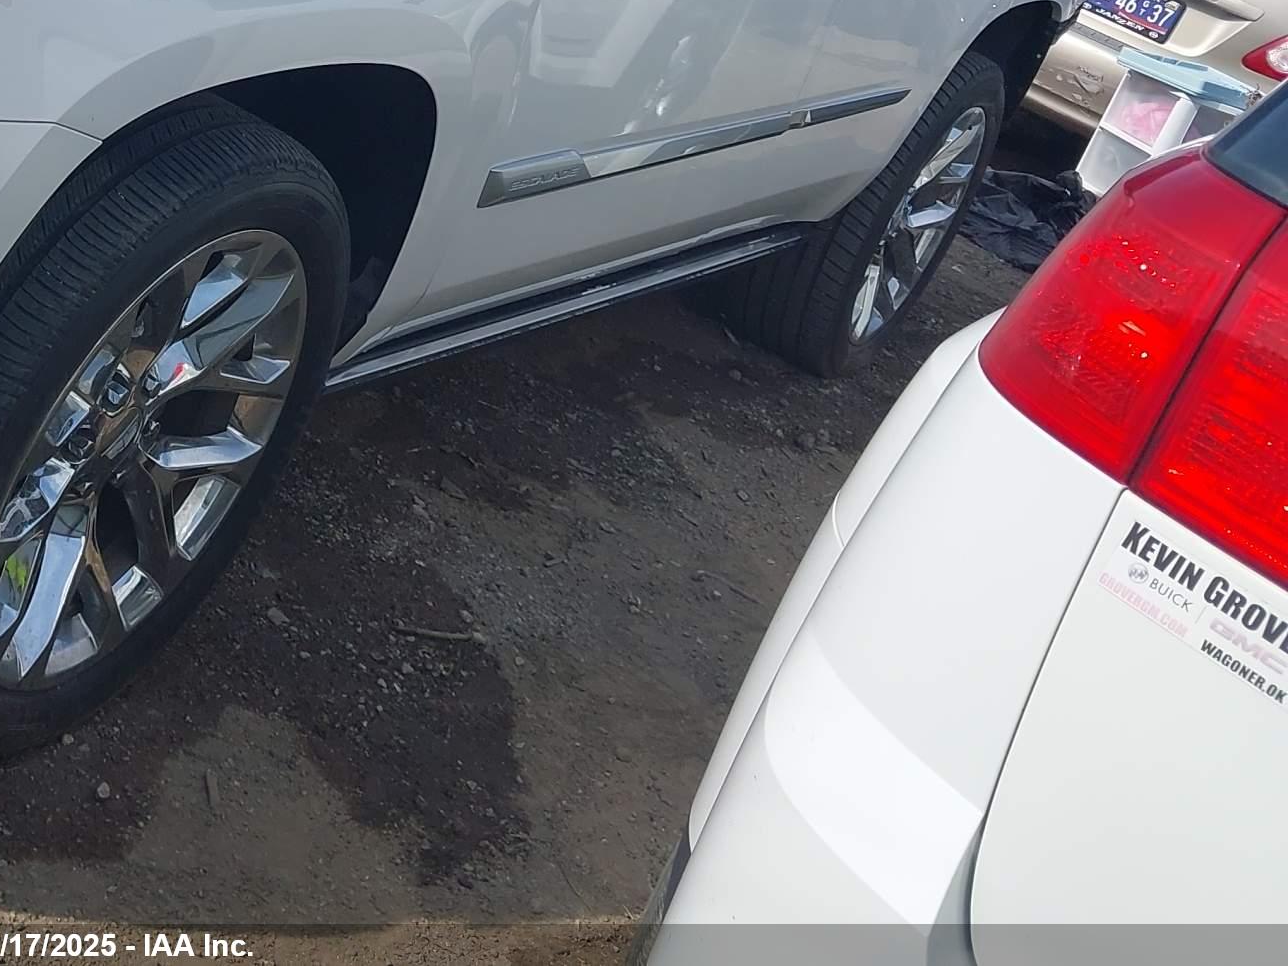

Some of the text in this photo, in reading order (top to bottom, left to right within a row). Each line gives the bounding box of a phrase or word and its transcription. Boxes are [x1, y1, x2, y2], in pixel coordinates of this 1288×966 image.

[1095, 8, 1144, 31] JANZEN
[1147, 4, 1174, 26] 37
[1121, 521, 1205, 592] KEVIN
[1149, 578, 1195, 613] BUICK
[1209, 617, 1287, 675] GMC
